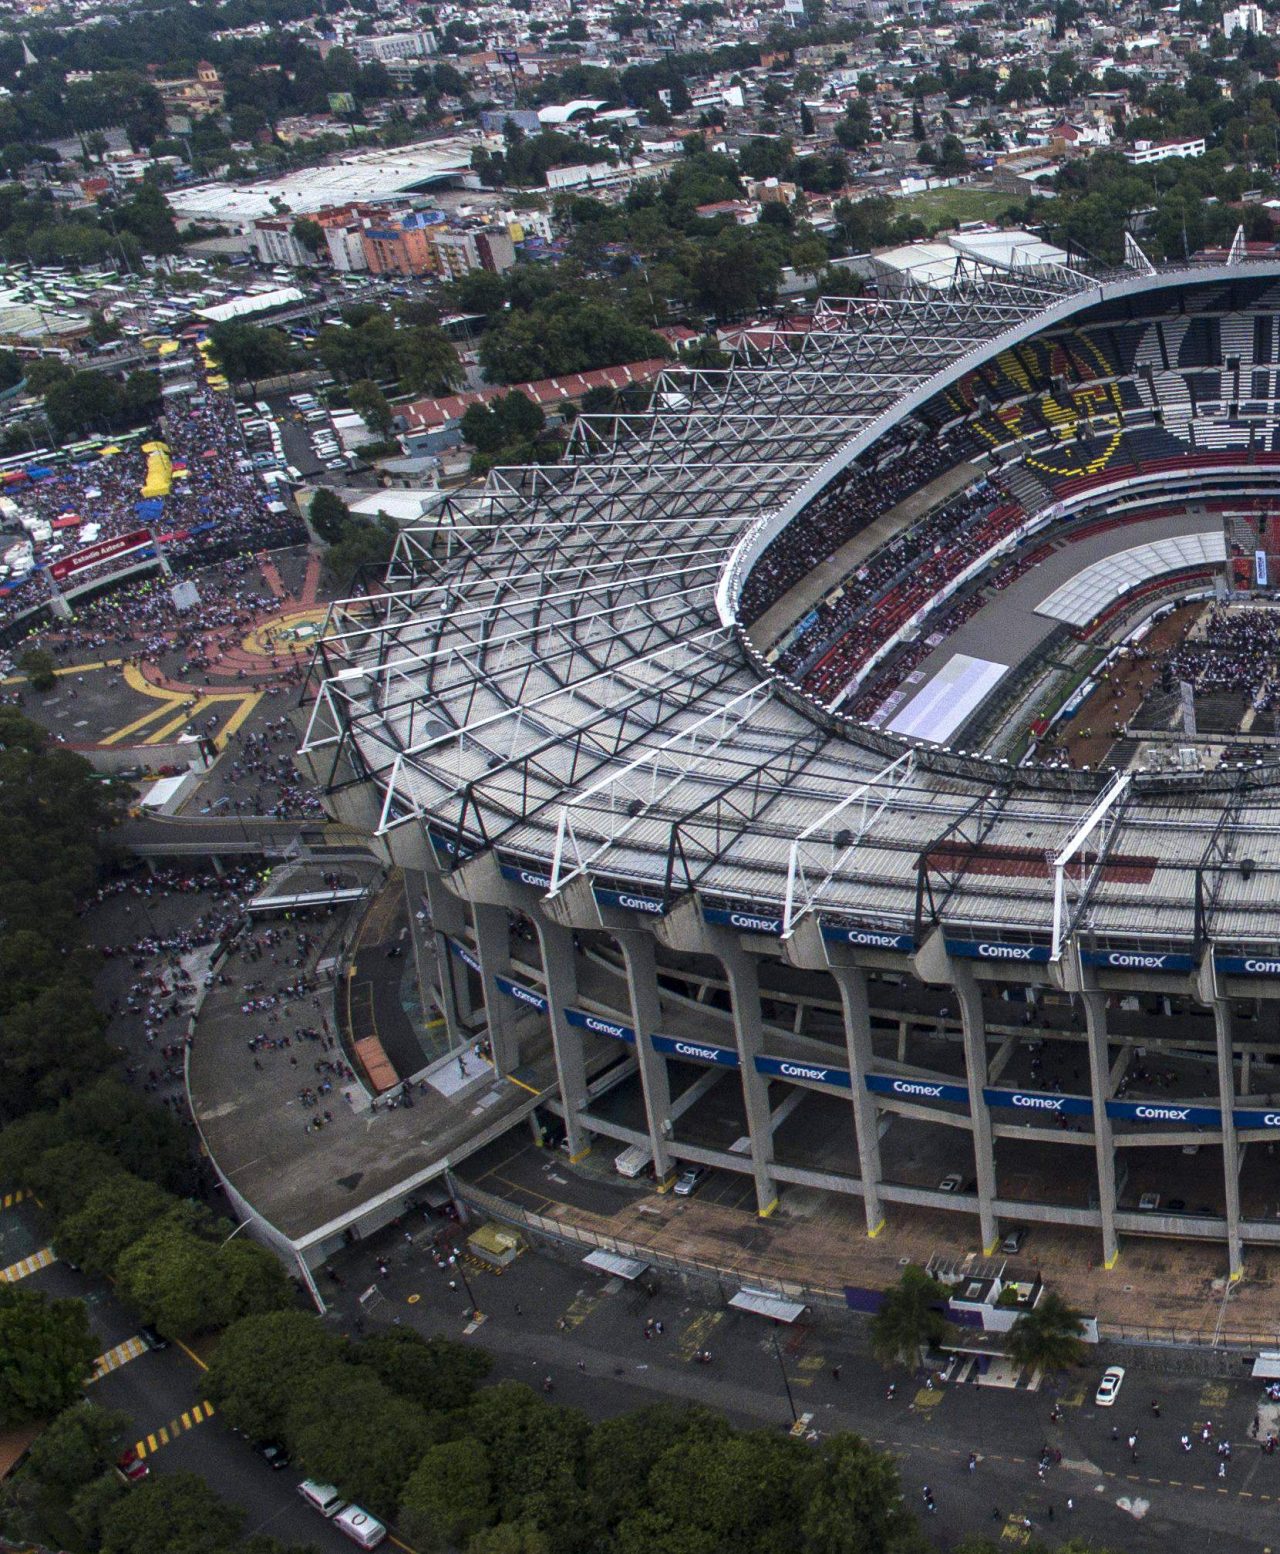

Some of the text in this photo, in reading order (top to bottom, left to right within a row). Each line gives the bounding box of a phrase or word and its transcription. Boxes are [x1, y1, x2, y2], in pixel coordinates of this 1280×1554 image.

[73, 541, 126, 565] Estadio Azteca
[520, 872, 551, 888] Come
[618, 895, 664, 913] Comex
[730, 914, 779, 932] Comex
[848, 931, 904, 947] Comex
[978, 944, 1034, 959] Comex
[1109, 953, 1166, 968] Comex
[586, 1018, 623, 1037] Comex
[675, 1042, 719, 1060] Comex
[780, 1063, 828, 1080] Comex
[893, 1081, 943, 1097] Comex
[1012, 1095, 1064, 1110] Comex
[1135, 1106, 1190, 1120] Comex
